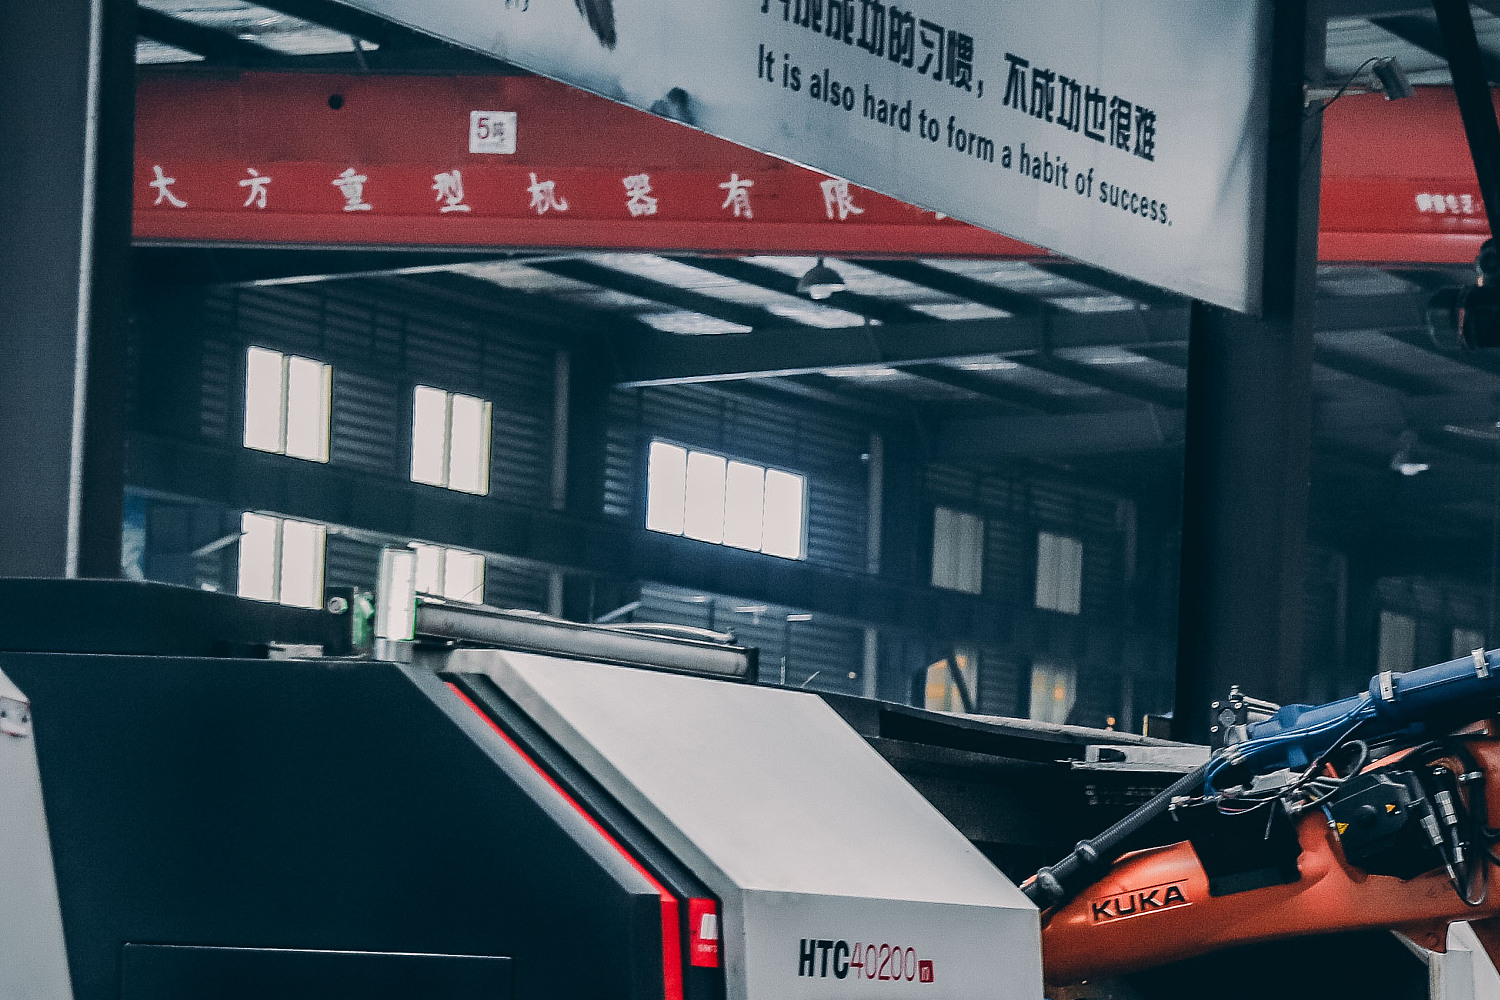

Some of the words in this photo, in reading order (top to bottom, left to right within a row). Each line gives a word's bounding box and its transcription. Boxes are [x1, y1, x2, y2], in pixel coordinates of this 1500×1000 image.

[761, 0, 1156, 162] 成成功的习惯，不成功也很难
[757, 43, 775, 83] It
[783, 53, 801, 92] is
[809, 68, 855, 111] also
[863, 83, 912, 132] hard
[918, 109, 940, 142] to
[947, 115, 994, 163] form
[1001, 145, 1012, 169] a
[1019, 142, 1068, 190] habit
[1075, 167, 1094, 197] of
[1100, 181, 1172, 226] success.
[149, 165, 946, 220] 大方重型机器有限
[1092, 885, 1186, 921] KUKA
[798, 938, 917, 982] HTC40200
